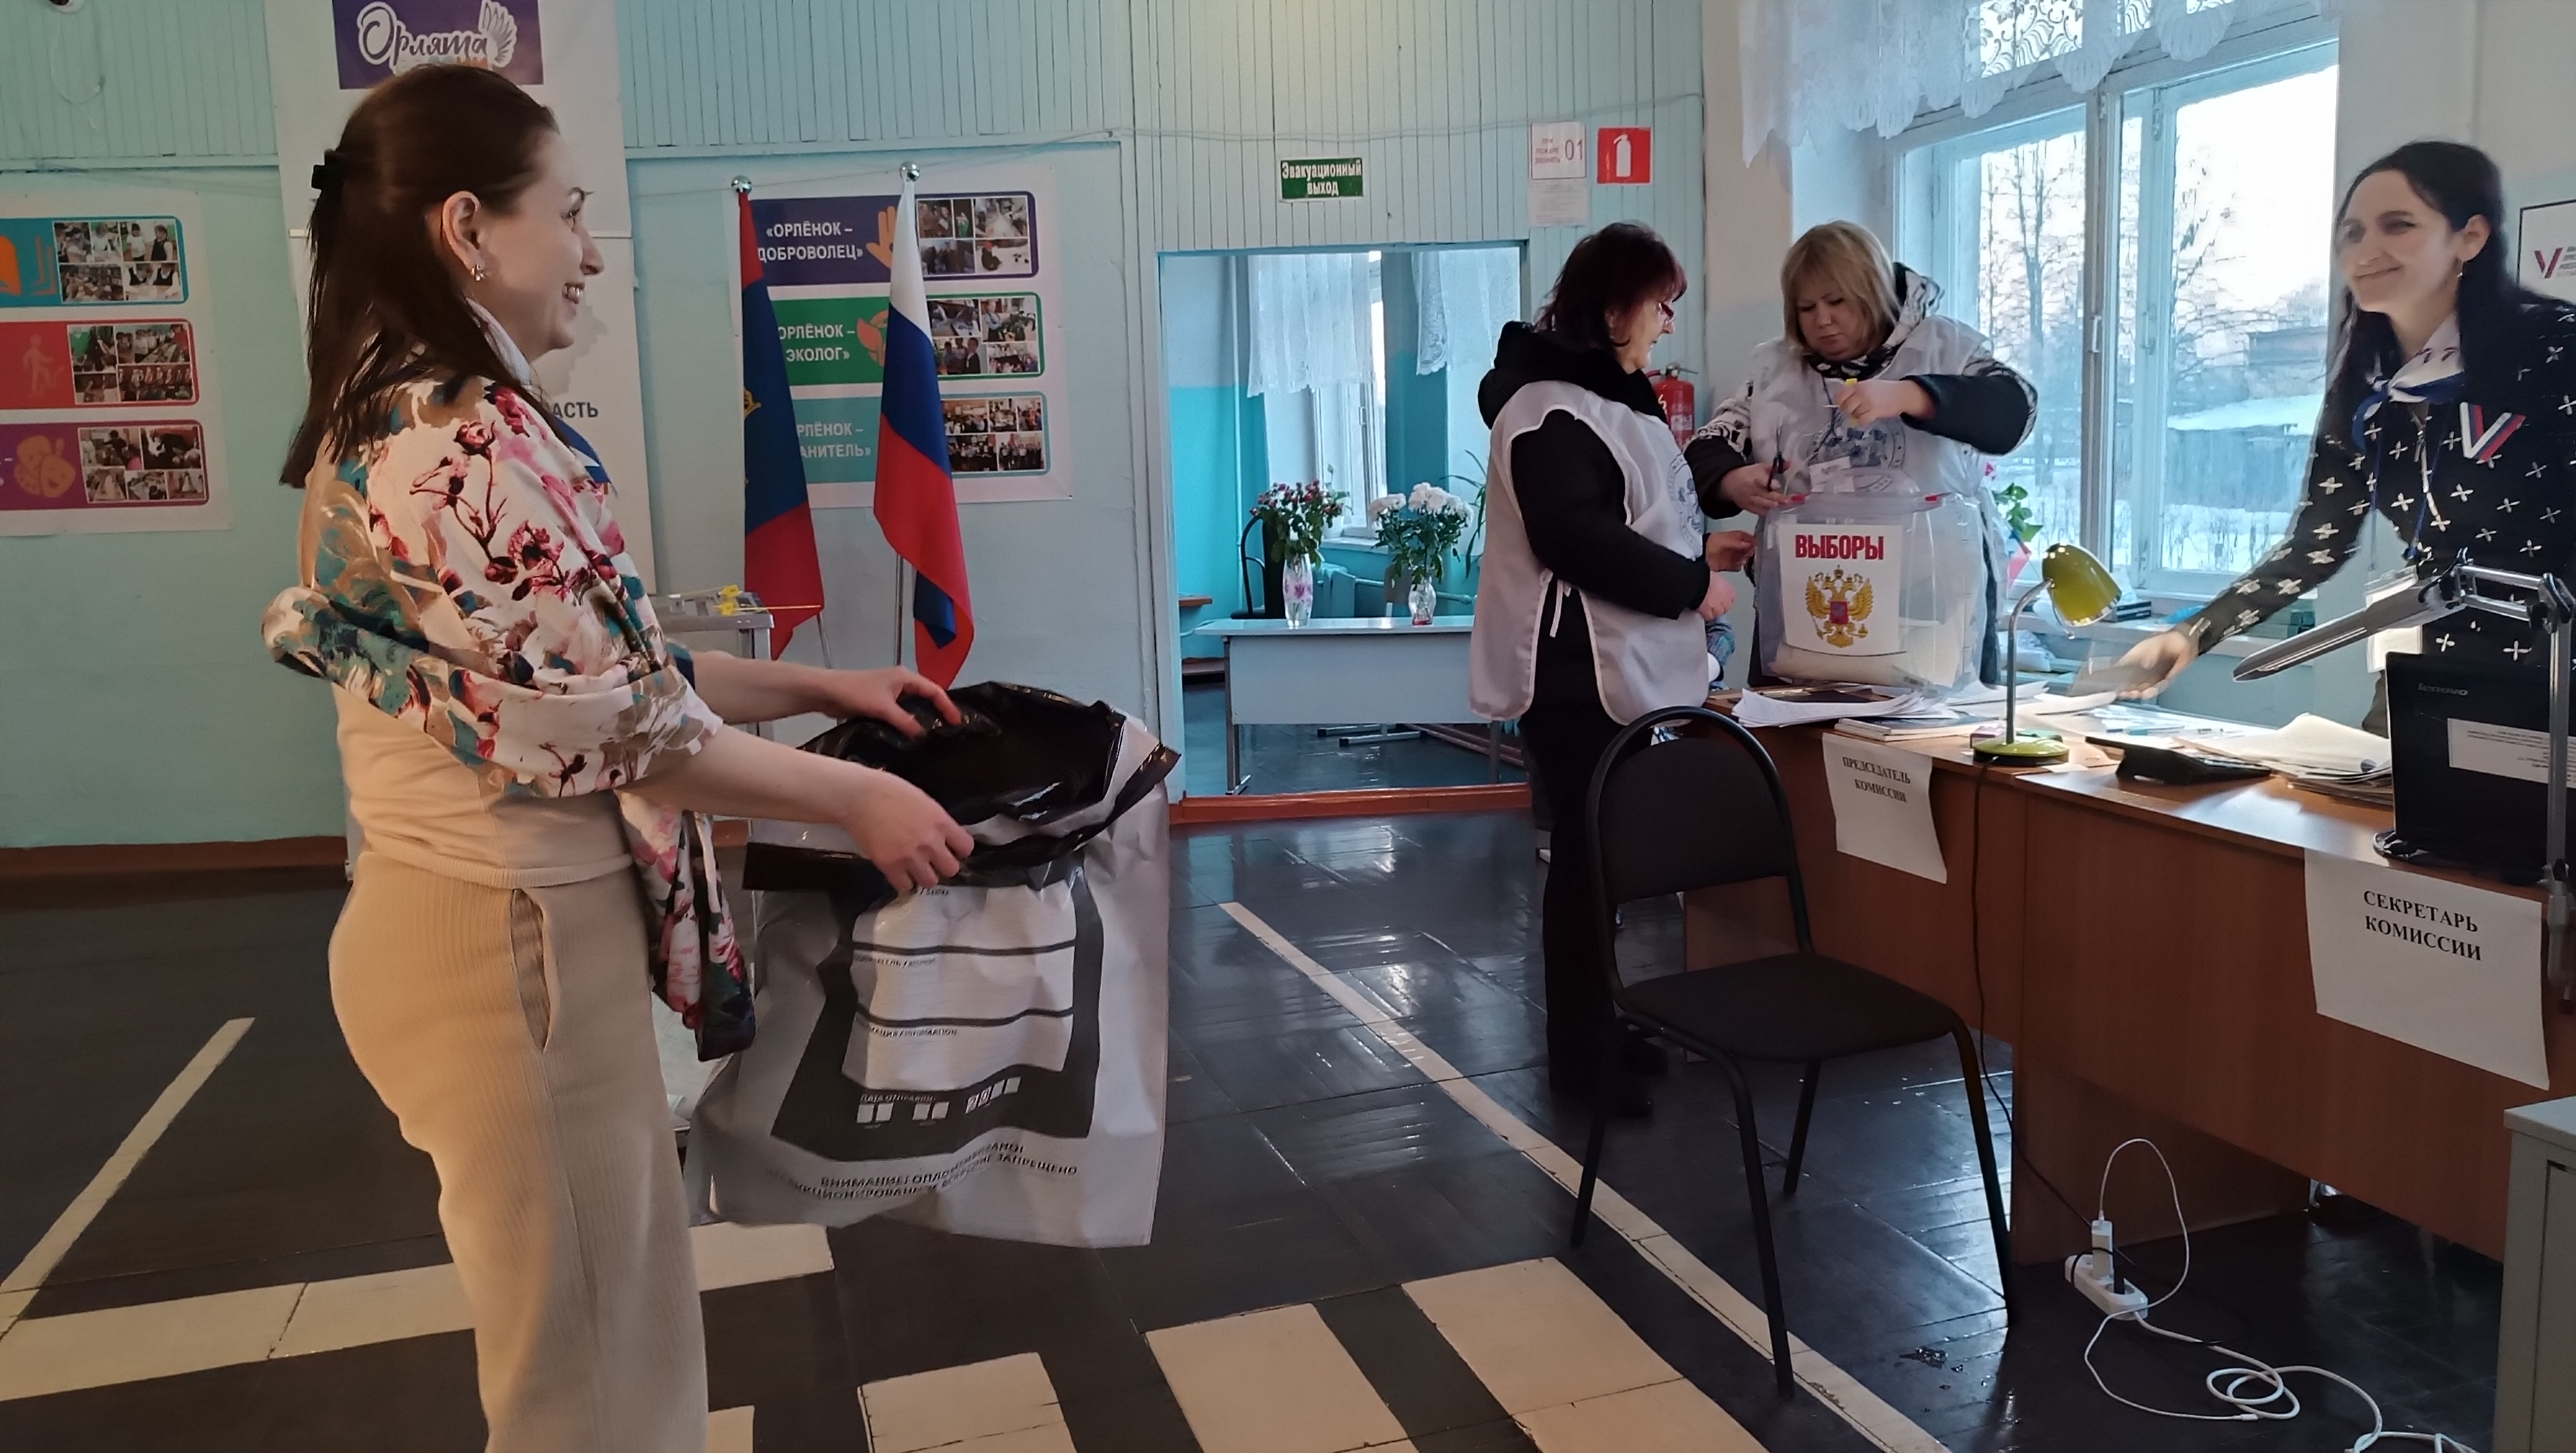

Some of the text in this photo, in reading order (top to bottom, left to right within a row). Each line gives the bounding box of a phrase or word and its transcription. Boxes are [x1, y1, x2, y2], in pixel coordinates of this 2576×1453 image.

[361, 6, 488, 66] Орлята
[1565, 138, 1583, 161] 01
[1282, 159, 1361, 181] Эвакуационный
[766, 221, 841, 237] «ОРЛЁНОК
[758, 245, 864, 263] ДОБРОВОЛЕЦ»
[778, 323, 844, 340] ОРЛЁНОК
[786, 347, 850, 362] ЭКОЛОГ»
[553, 402, 598, 418] АСТЬ
[797, 421, 853, 437] РЛЁНОК
[800, 444, 871, 458] АНИТЕЛЬ»
[1795, 535, 1884, 560] ВЫБОРЫ
[1842, 756, 1911, 784] ПРЕДСЕДАТЕЛЬ
[1855, 779, 1906, 803] КОМИССИИ
[2364, 891, 2477, 932] СЕКРЕТАРЬ
[2365, 915, 2482, 961] КОМИССИИ
